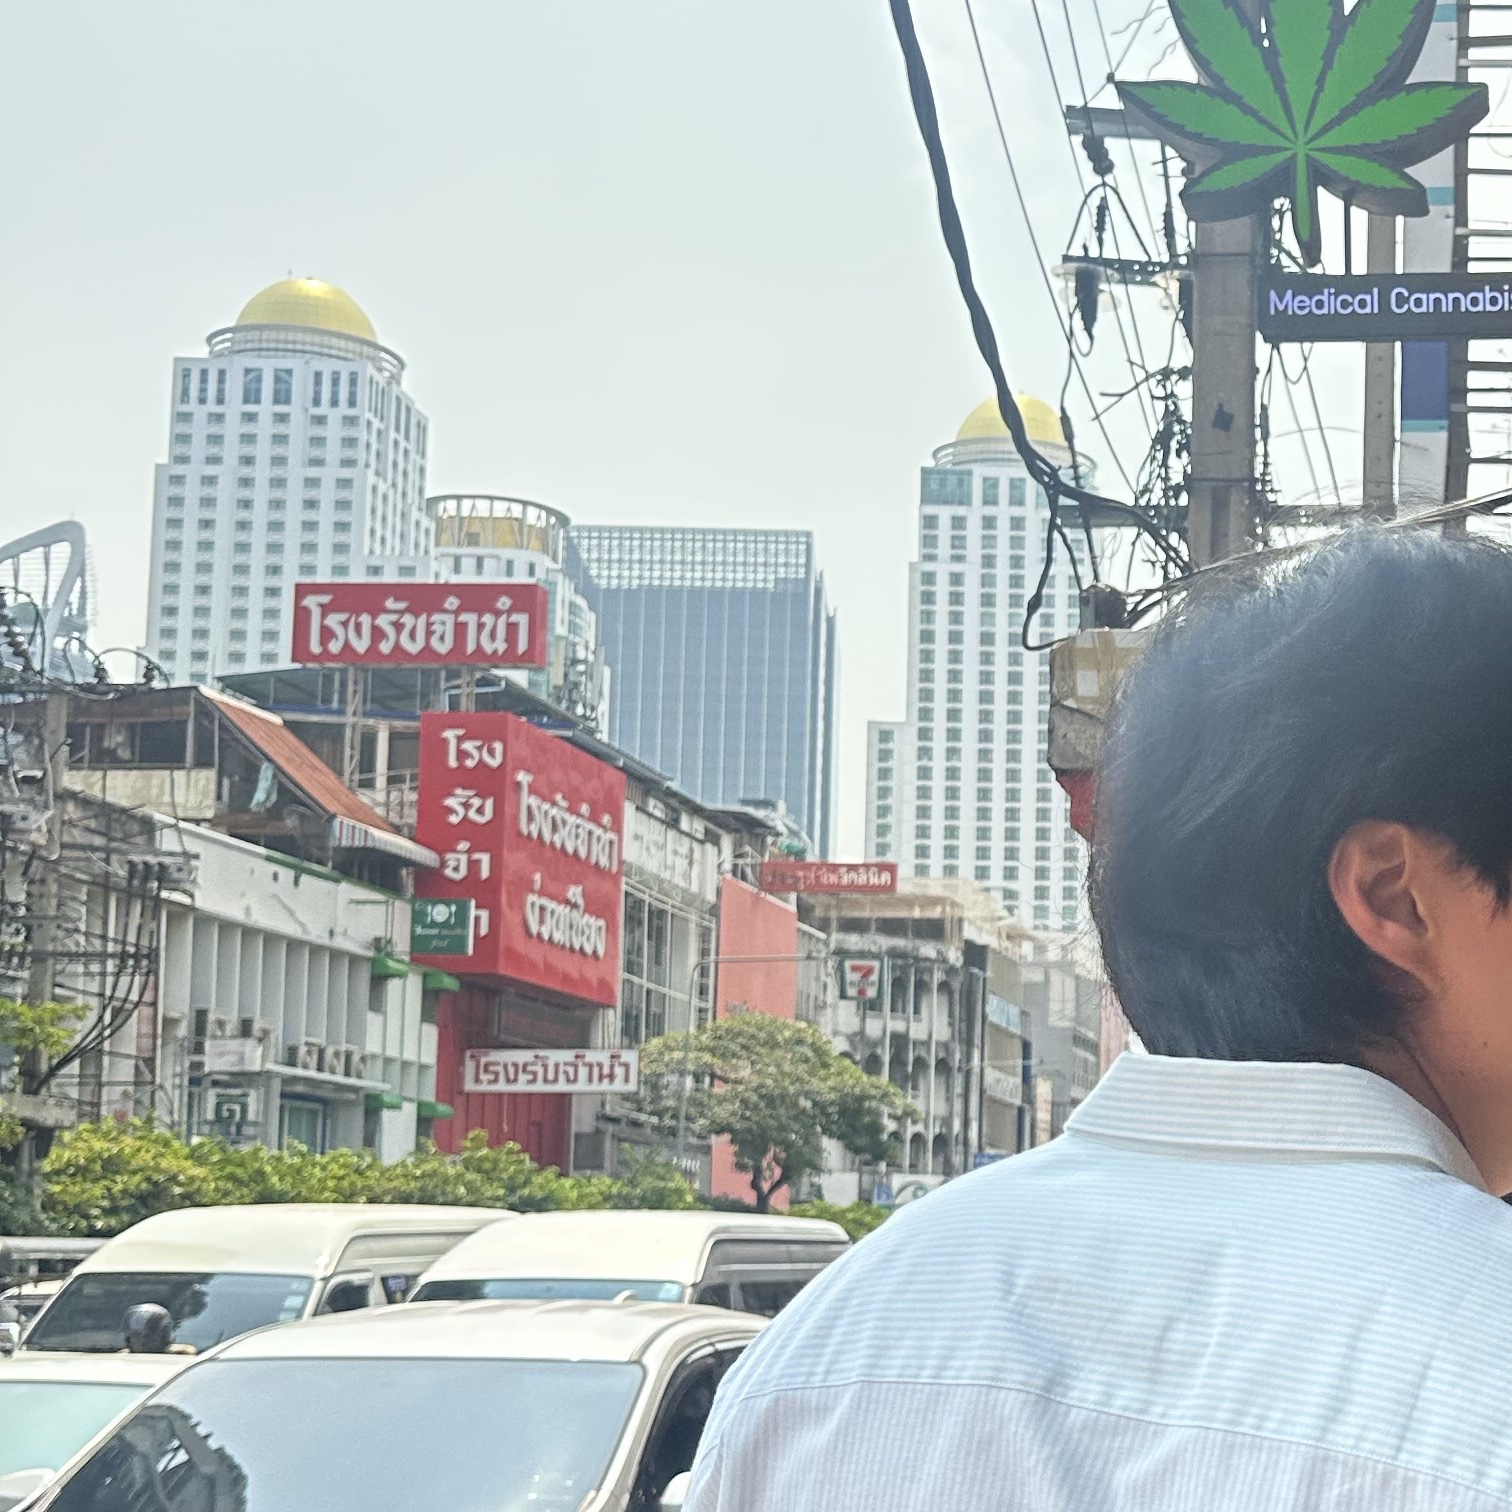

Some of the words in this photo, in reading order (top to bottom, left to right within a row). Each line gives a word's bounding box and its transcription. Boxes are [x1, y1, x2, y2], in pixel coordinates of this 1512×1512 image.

[1269, 287, 1379, 316] Medical
[301, 594, 530, 656] โรงรับจำนำ
[441, 728, 504, 769] โรง
[443, 787, 494, 826] รับ
[514, 769, 620, 873] โรงรับจำนำ
[443, 841, 491, 881] จำ
[469, 1053, 631, 1086] โรงรับจำนำ
